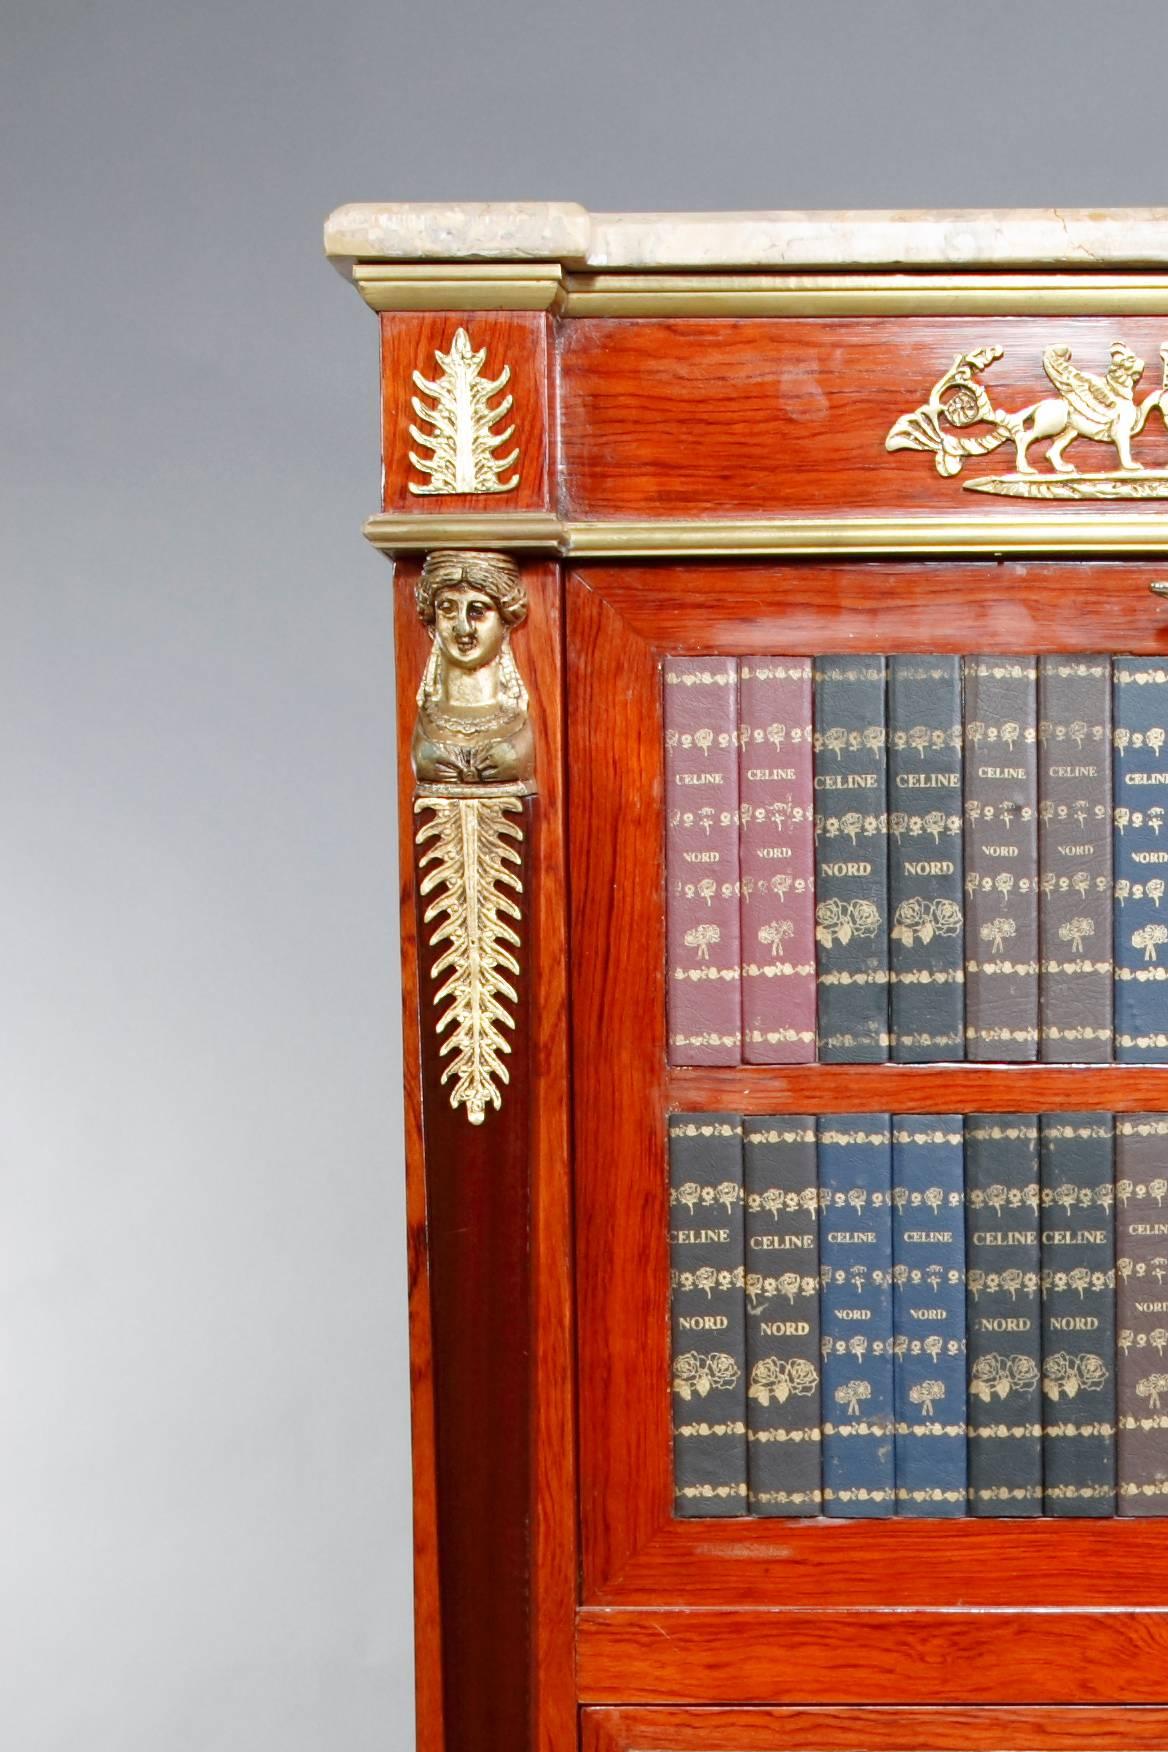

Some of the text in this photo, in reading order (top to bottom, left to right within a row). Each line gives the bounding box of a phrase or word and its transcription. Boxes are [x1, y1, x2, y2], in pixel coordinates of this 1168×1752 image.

[748, 768, 795, 781] CELINE
[978, 766, 1026, 780] CELINE
[1049, 766, 1097, 778] CELINE
[675, 773, 723, 786] CELINE
[814, 774, 878, 789] CELINE
[896, 773, 959, 788] CELINE
[683, 851, 719, 863] NORD
[757, 847, 791, 859] NORD
[982, 846, 1018, 857] NORD
[1058, 845, 1093, 856] NORD
[1132, 852, 1168, 864] NORD
[821, 862, 871, 877] NORD
[904, 861, 954, 876] NORD
[669, 1229, 730, 1244] CELINE
[750, 1235, 814, 1250] CELINE
[828, 1231, 876, 1244] CELINE
[904, 1231, 952, 1243] CELINE
[973, 1231, 1036, 1246] CELINE
[1042, 1230, 1106, 1245] CELINE
[835, 1309, 871, 1321] NORD
[910, 1309, 946, 1321] NORD
[679, 1315, 728, 1330] NORD
[760, 1321, 809, 1336] NORD
[981, 1317, 1031, 1333] NORD
[1049, 1316, 1098, 1331] NORD
